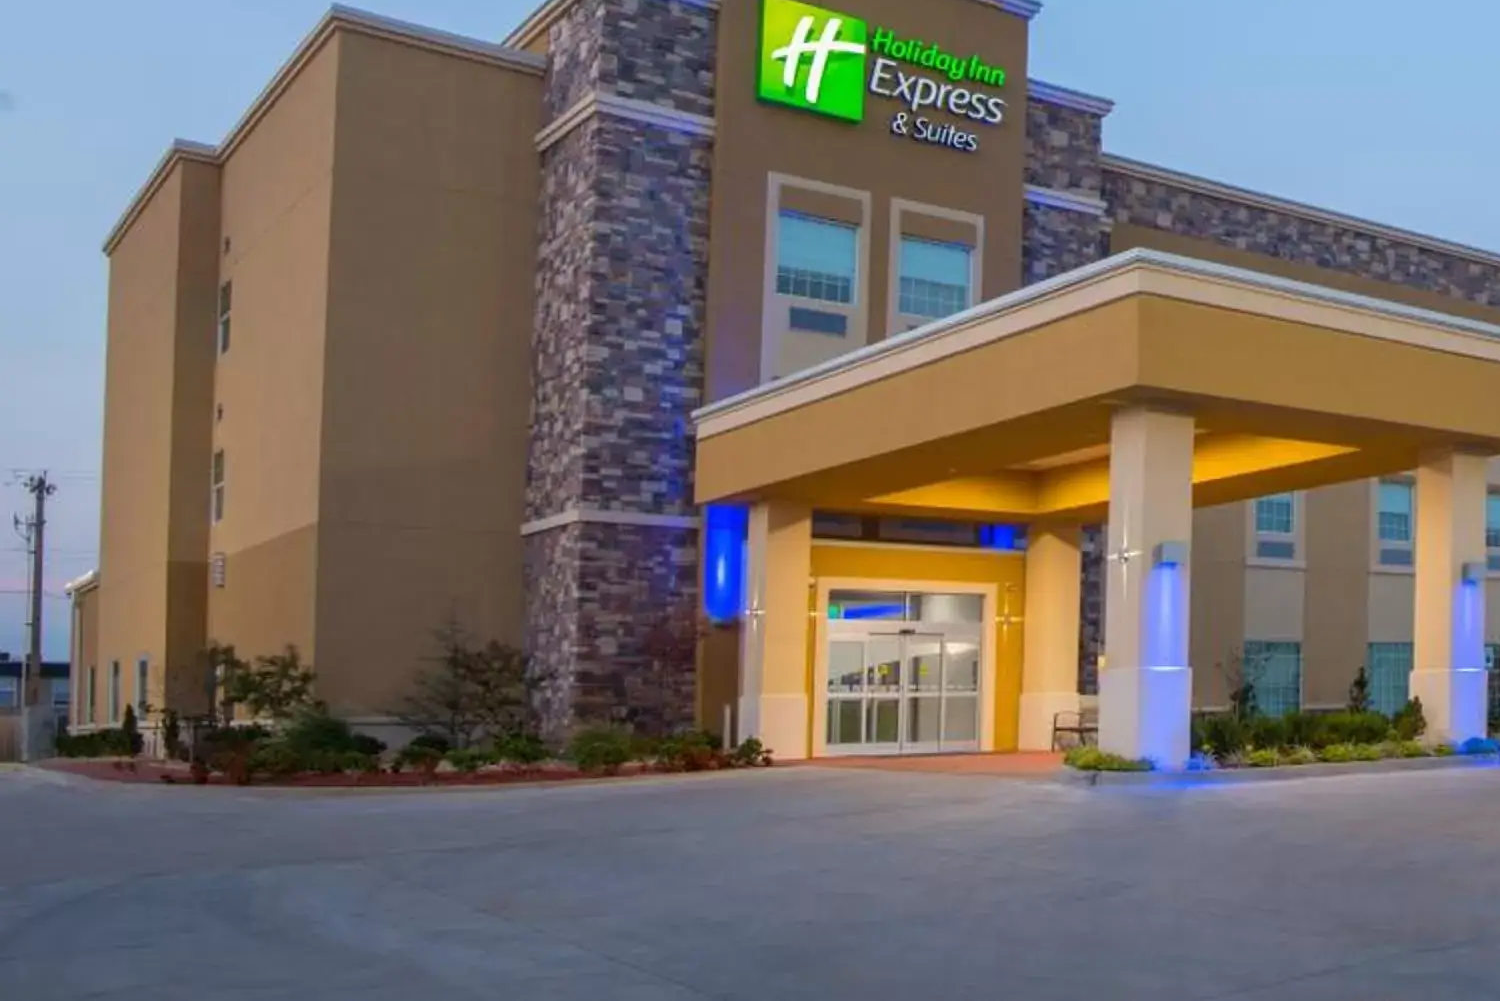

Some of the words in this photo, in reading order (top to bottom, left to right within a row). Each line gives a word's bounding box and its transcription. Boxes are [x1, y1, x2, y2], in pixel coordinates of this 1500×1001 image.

[872, 26, 966, 80] Holiday
[968, 54, 1006, 87] Inn
[870, 57, 1007, 123] Express
[891, 112, 908, 135] &
[913, 116, 978, 151] Suites
